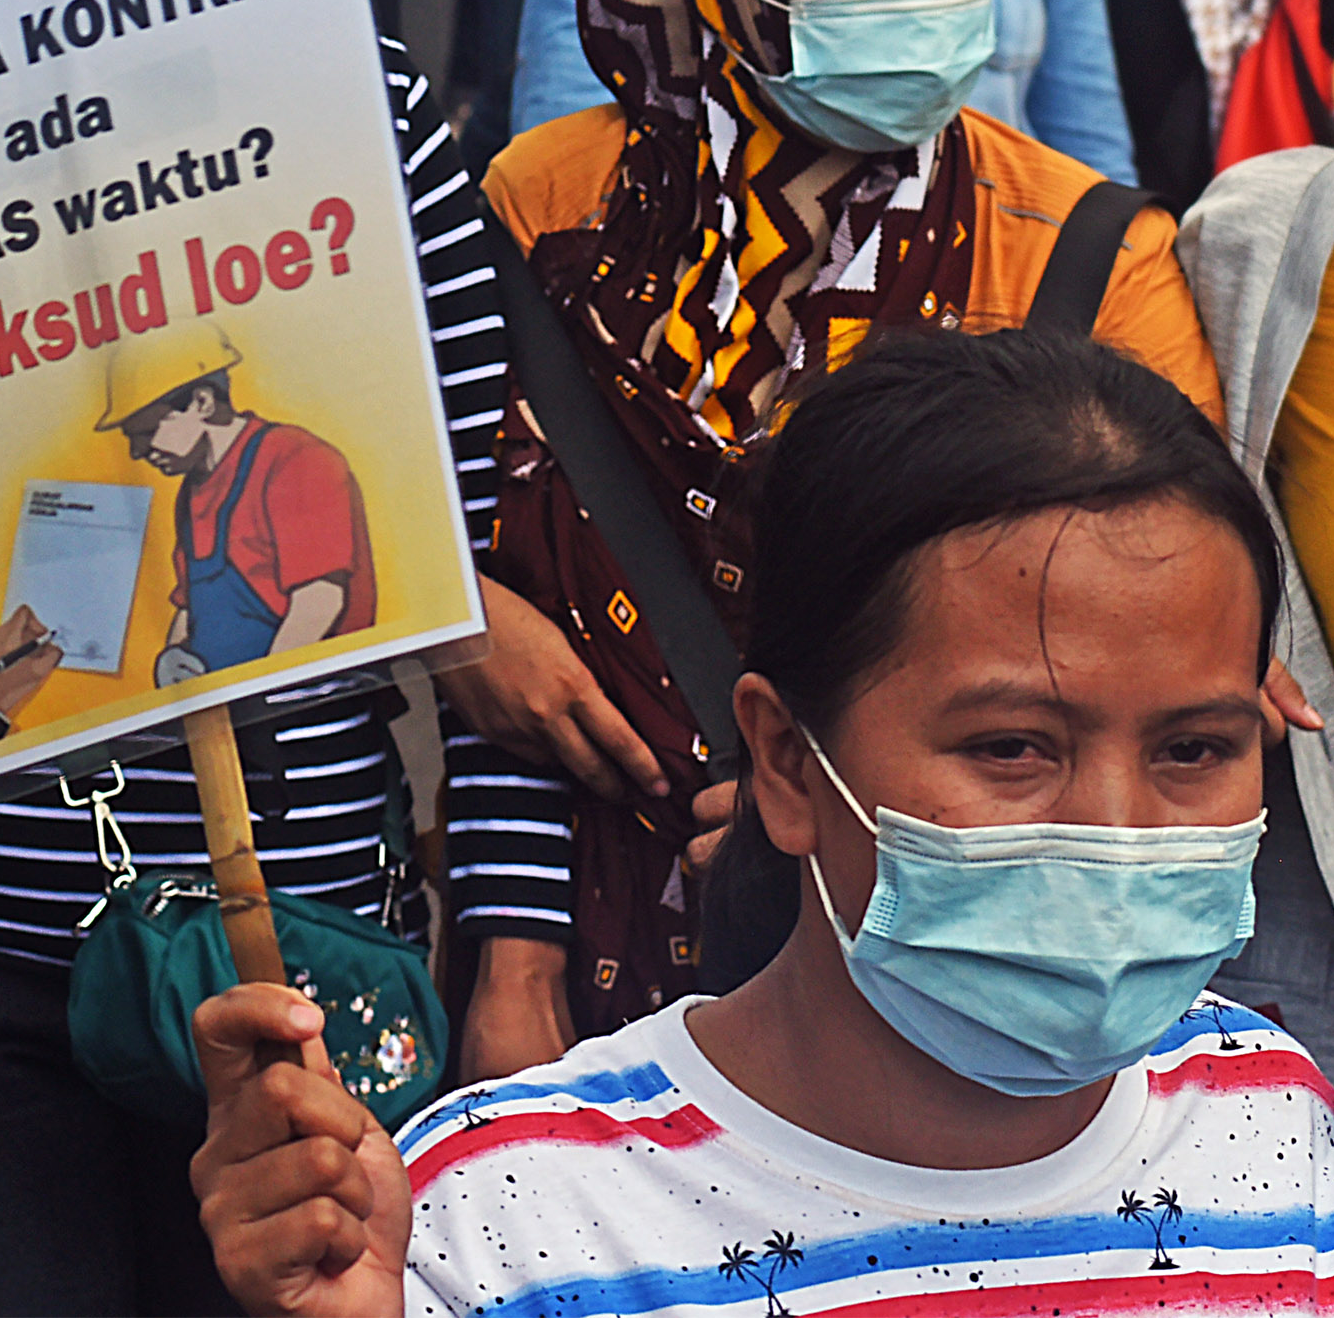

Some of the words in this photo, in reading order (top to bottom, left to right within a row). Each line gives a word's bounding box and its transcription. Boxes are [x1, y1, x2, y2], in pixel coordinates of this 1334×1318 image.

[4, 94, 113, 162] ada
[54, 127, 275, 235] waktu?
[185, 196, 355, 316] loe?
